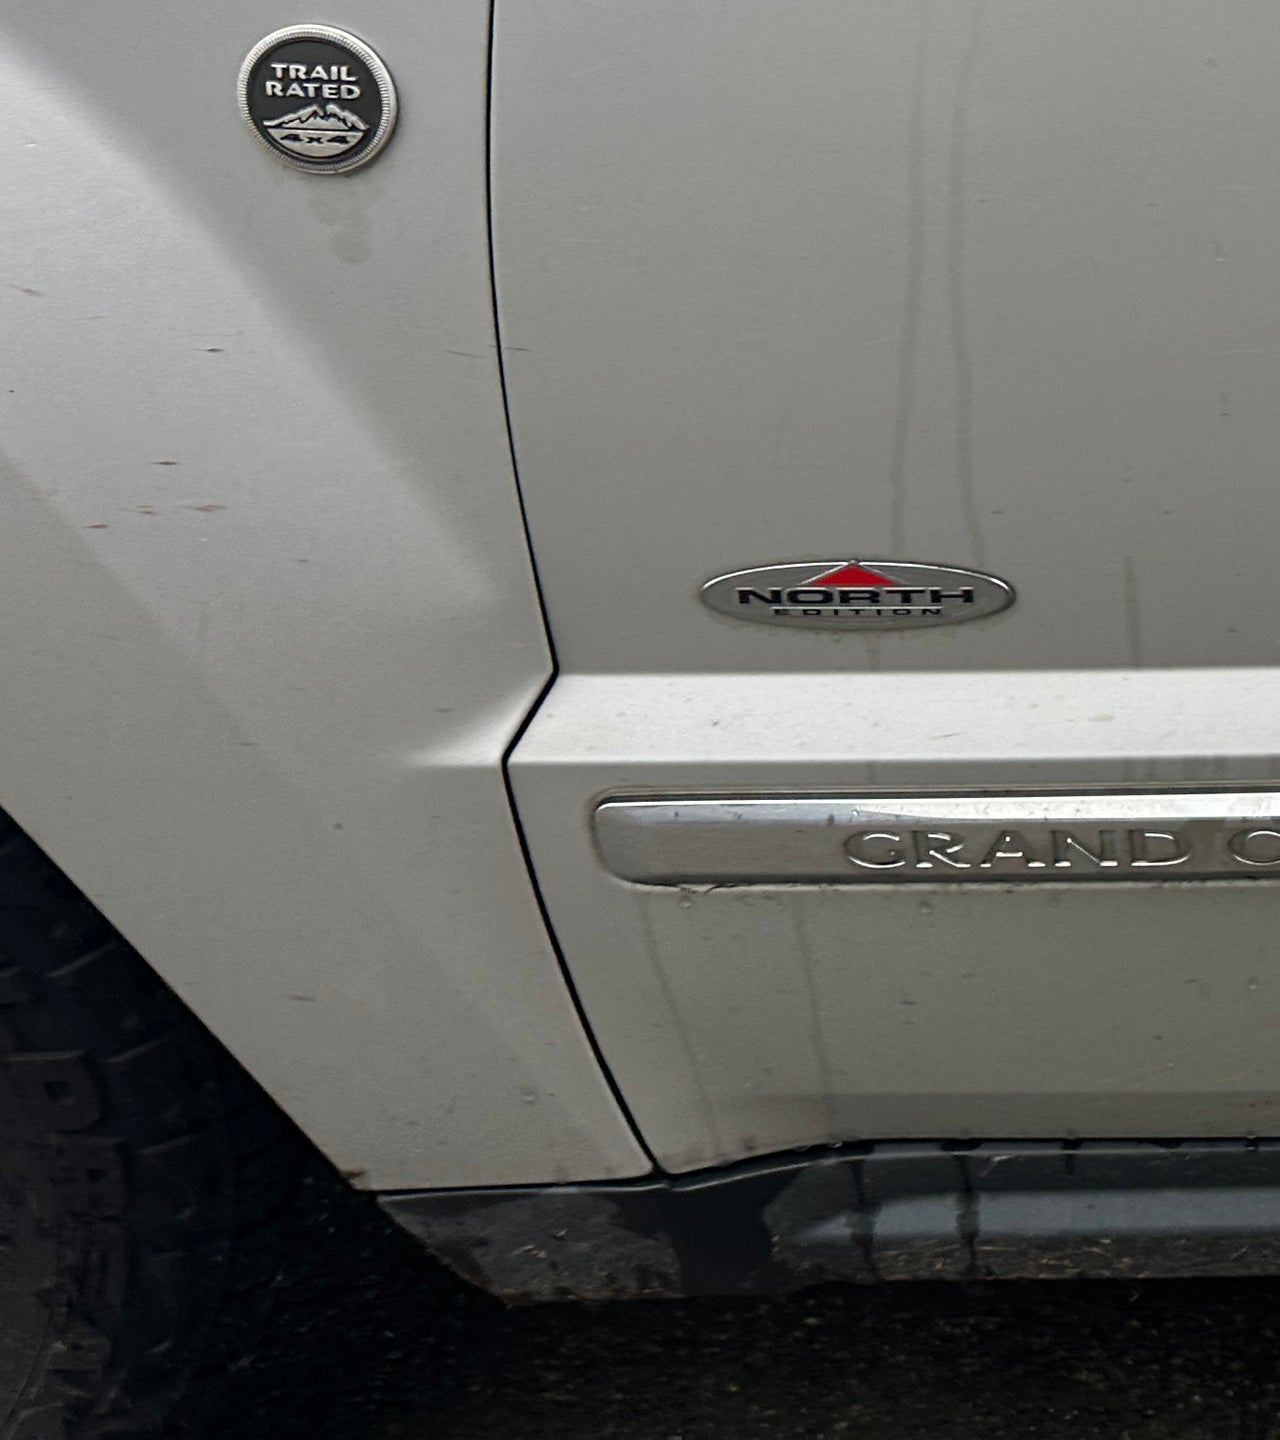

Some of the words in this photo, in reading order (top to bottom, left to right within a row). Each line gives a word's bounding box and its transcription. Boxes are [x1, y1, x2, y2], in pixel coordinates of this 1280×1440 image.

[270, 63, 359, 81] TRAIL
[264, 81, 361, 100] RATED
[735, 587, 974, 604] NORTH
[772, 607, 943, 616] EDITION
[843, 829, 1193, 868] GRAND
